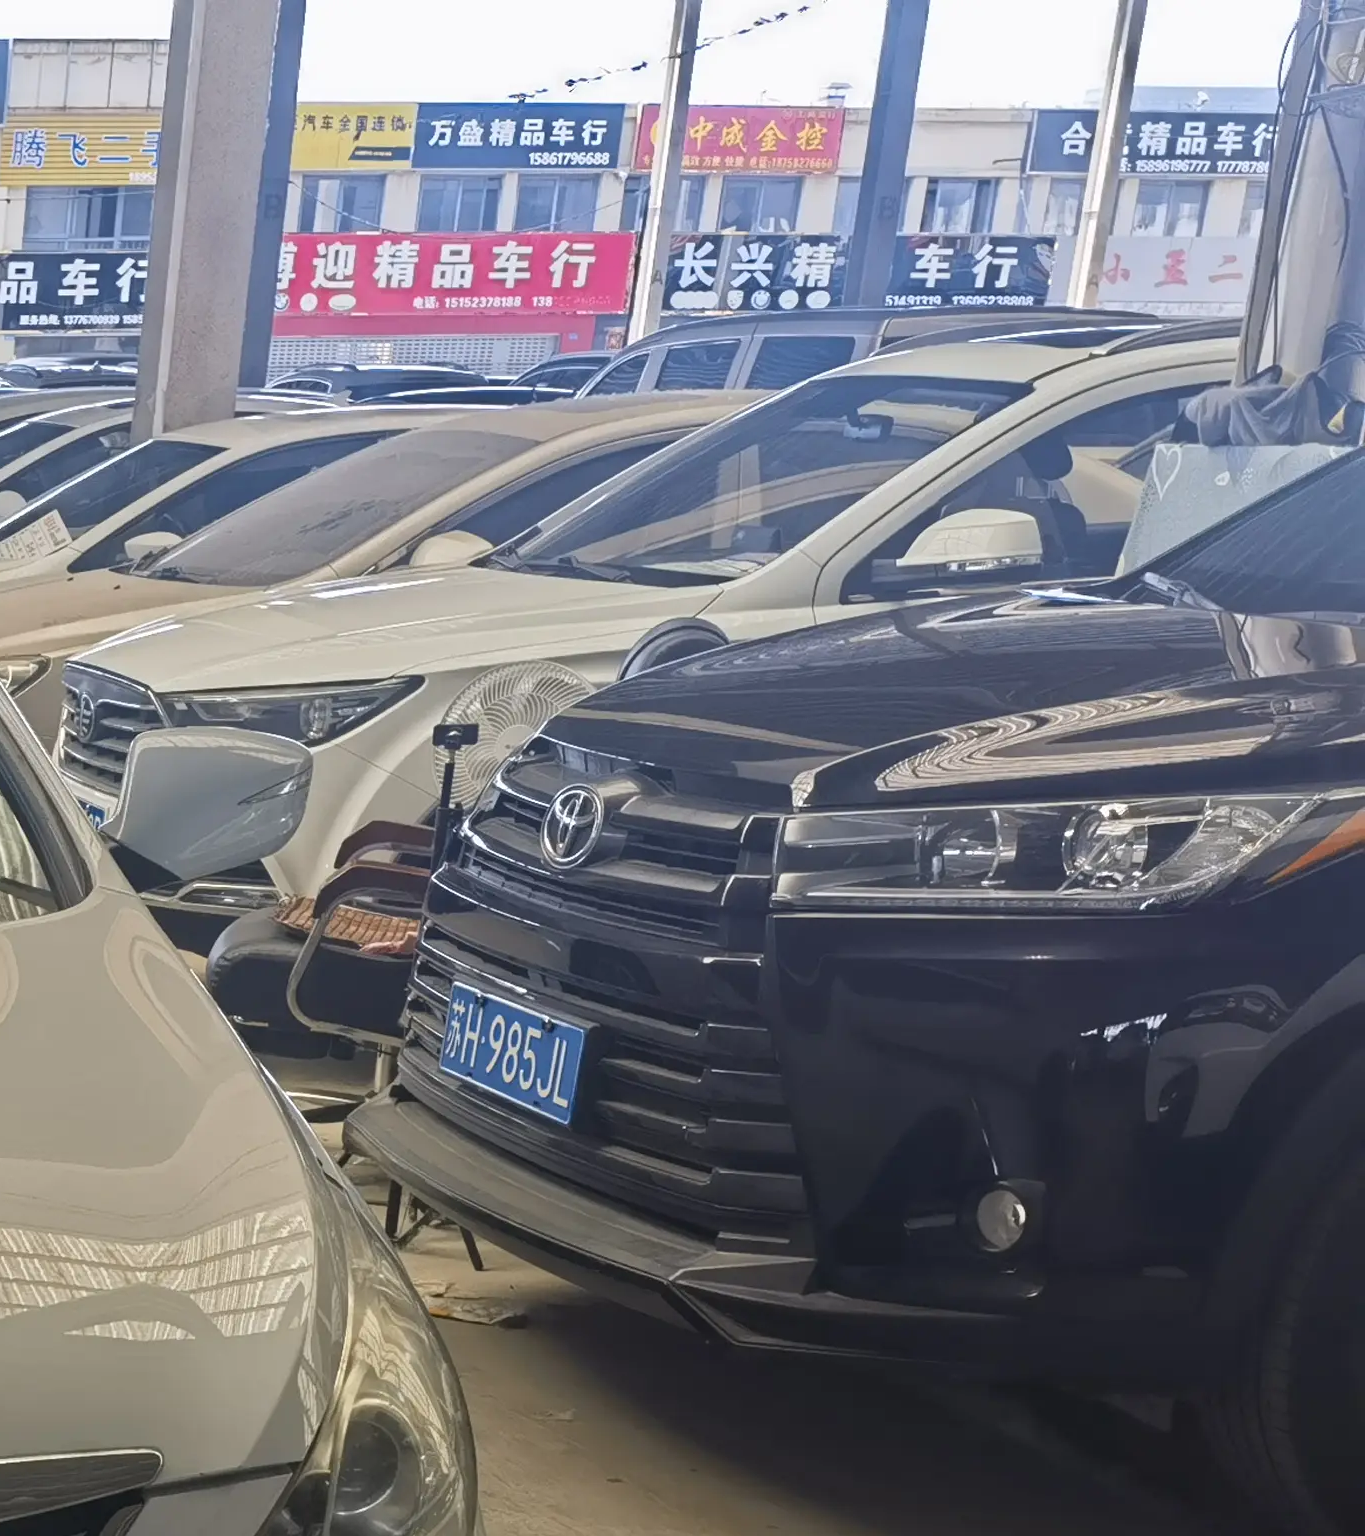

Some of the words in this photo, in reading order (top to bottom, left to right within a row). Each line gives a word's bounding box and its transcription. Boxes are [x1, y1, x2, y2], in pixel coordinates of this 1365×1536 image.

[429, 118, 608, 147] 万盛精品车行
[688, 116, 829, 153] 中成金控
[1061, 120, 1279, 157] 合精品车行
